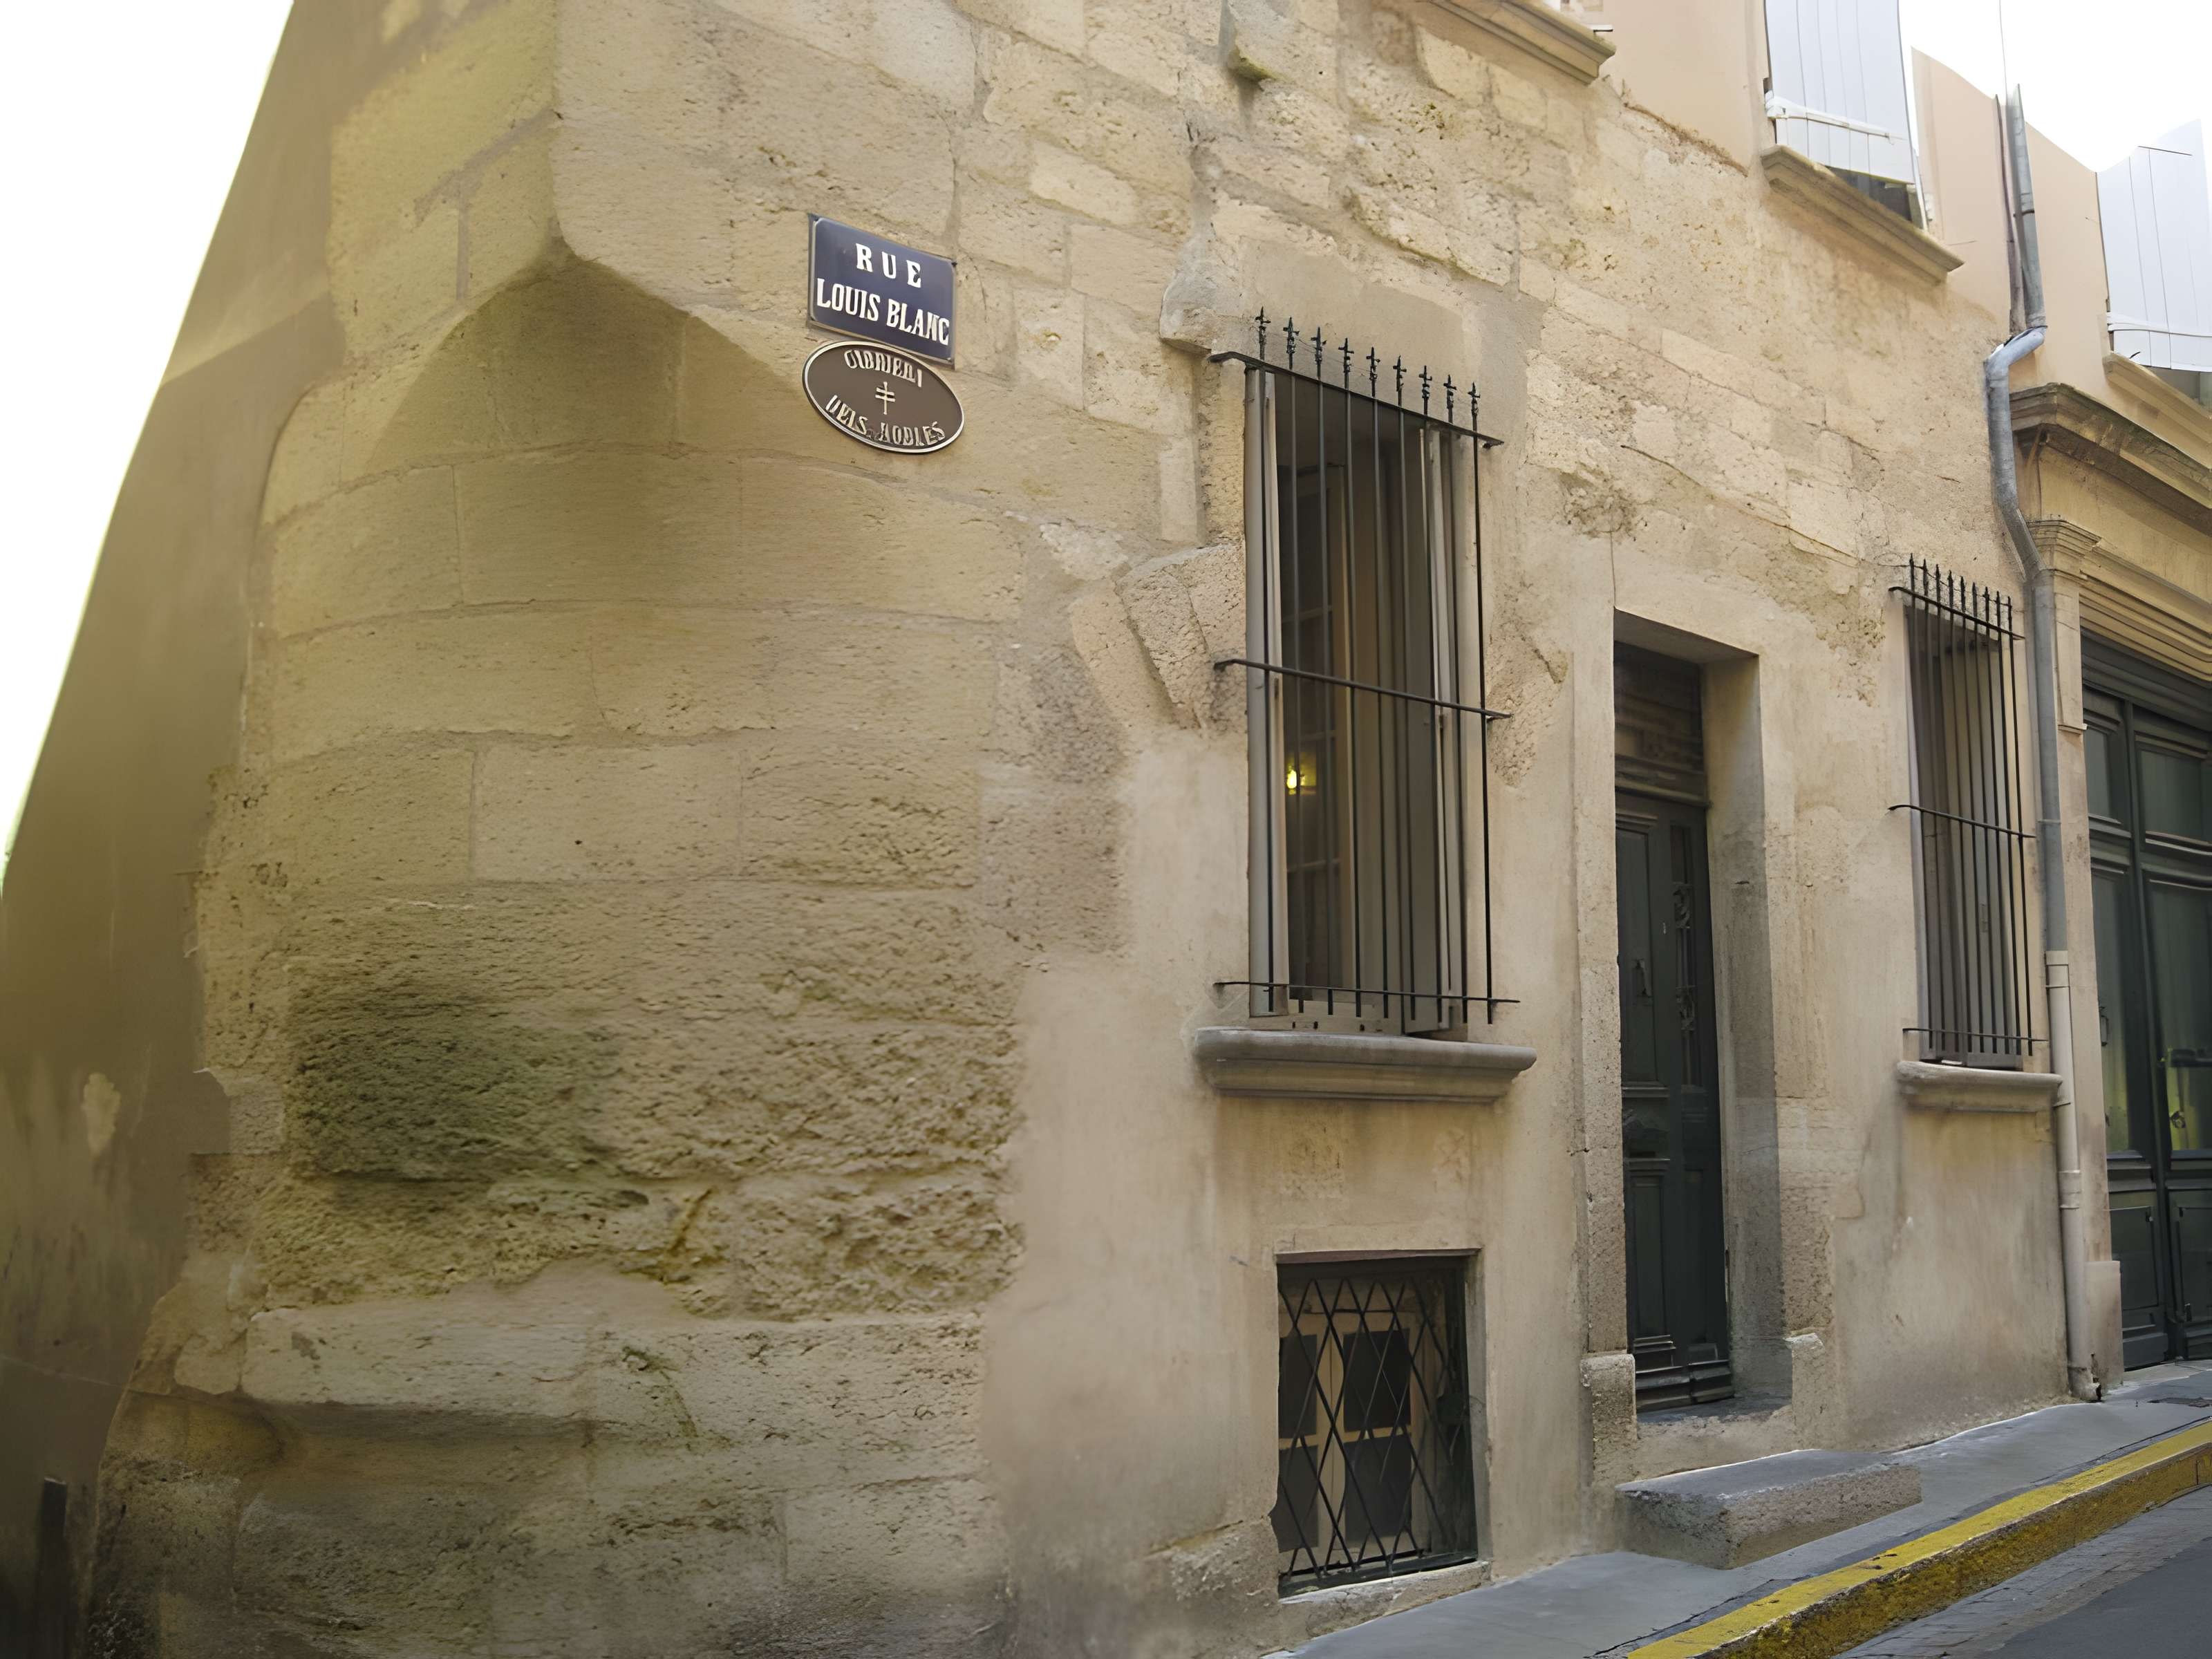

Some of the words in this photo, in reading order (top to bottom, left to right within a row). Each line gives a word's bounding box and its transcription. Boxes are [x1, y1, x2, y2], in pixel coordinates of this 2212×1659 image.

[856, 243, 921, 288] RUE
[817, 278, 881, 321] LOUIS
[886, 298, 950, 346] BLANC
